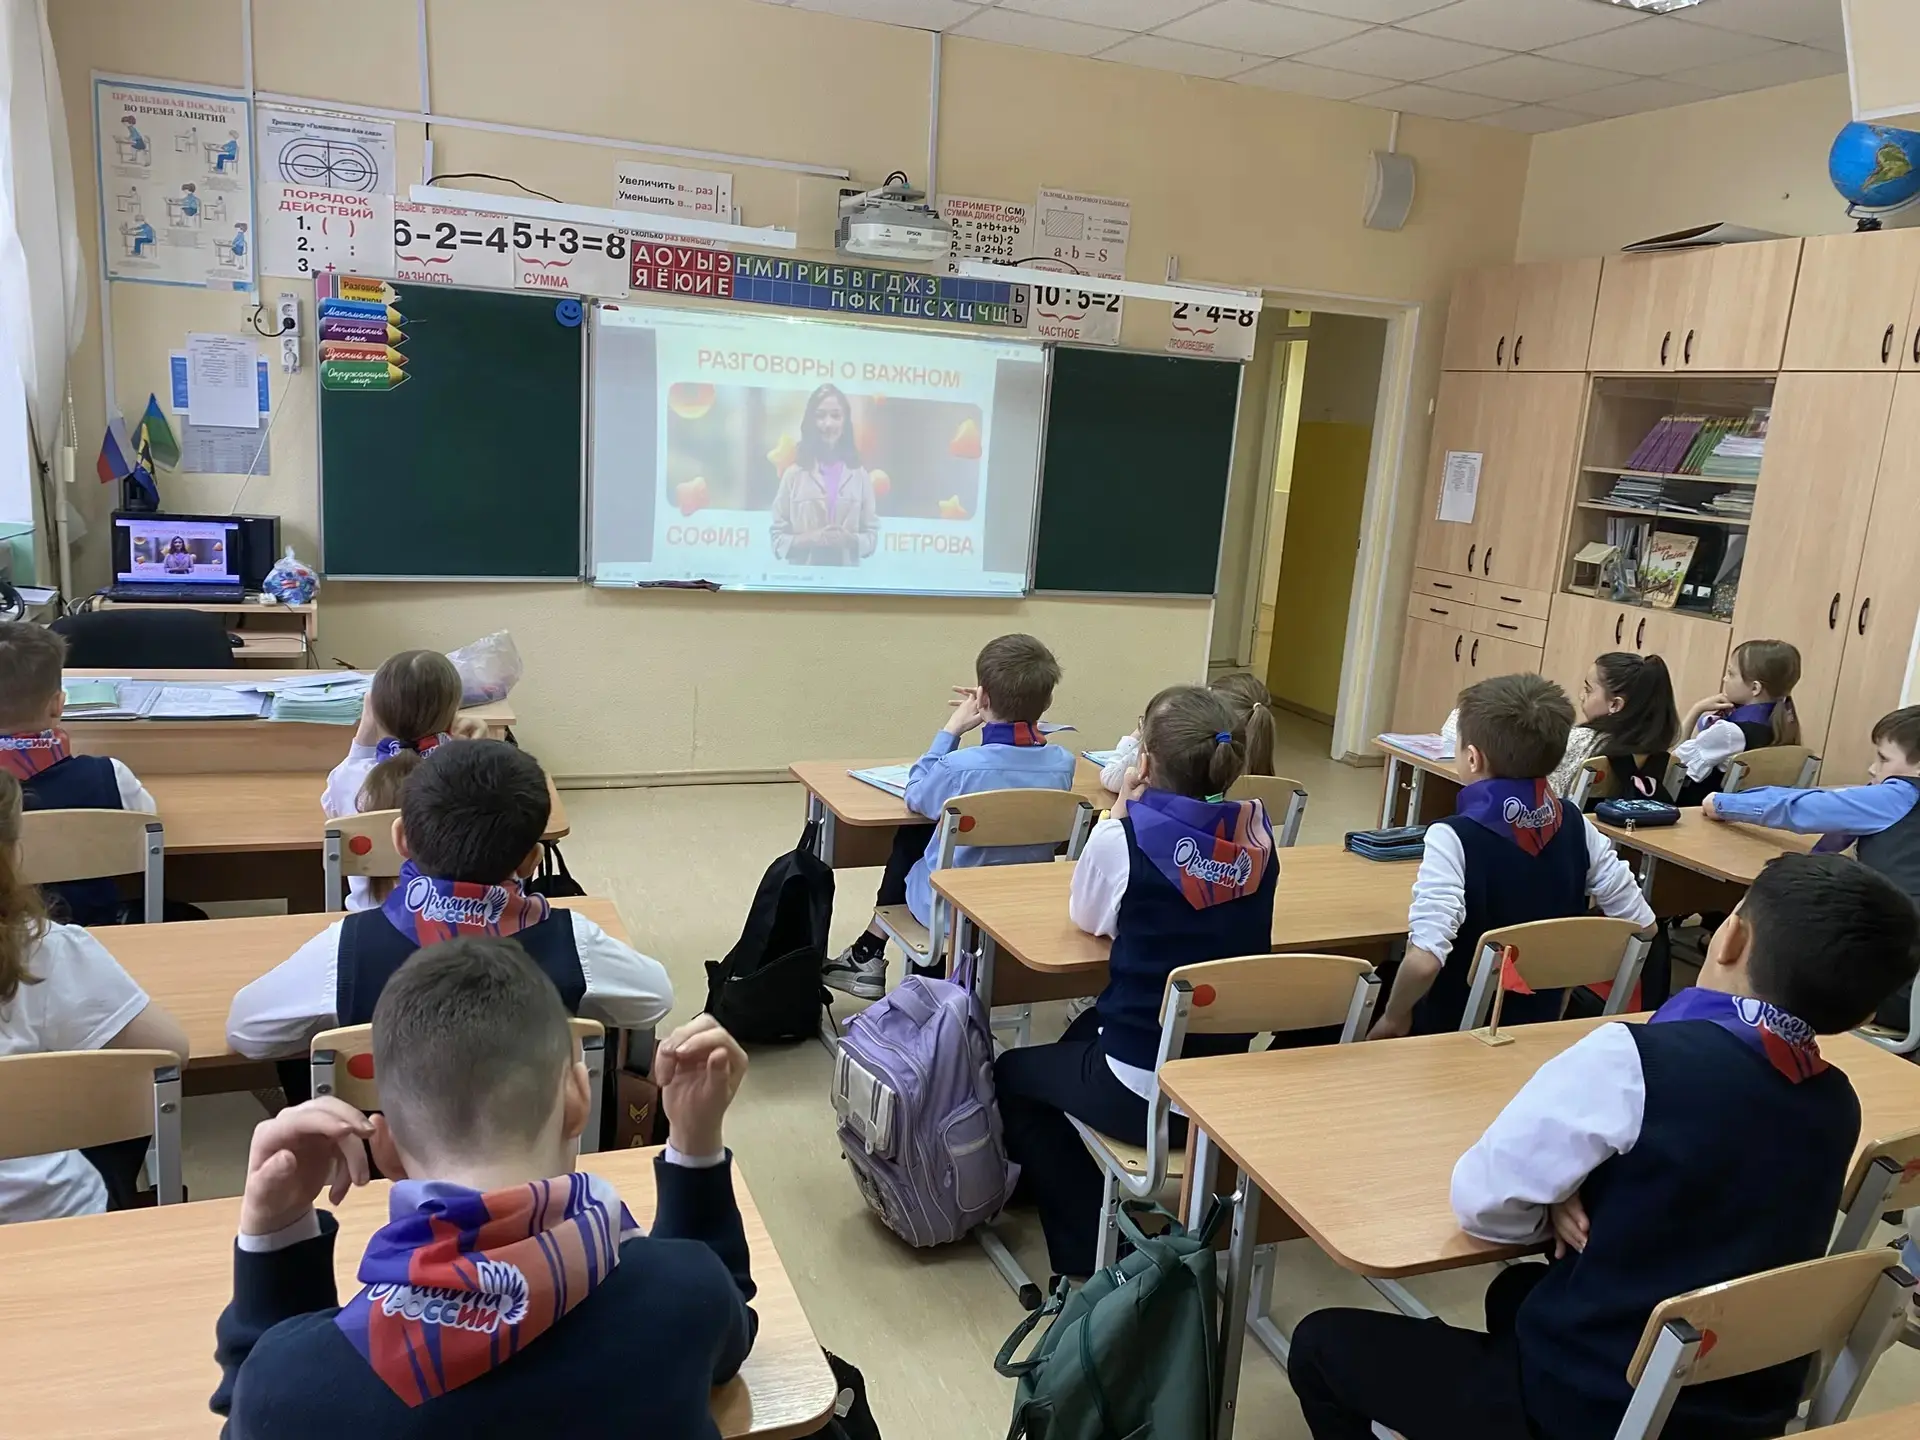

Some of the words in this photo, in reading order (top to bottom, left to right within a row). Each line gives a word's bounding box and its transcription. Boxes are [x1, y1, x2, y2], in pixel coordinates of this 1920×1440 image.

[124, 103, 137, 112] ВО
[140, 105, 174, 116] ВРЕМЯ
[176, 110, 226, 123] ЗАНЯТИЙ
[619, 175, 675, 191] Увеличить
[695, 187, 713, 196] раз
[283, 189, 368, 206] ПОРЯДОК
[618, 190, 675, 206] Уменьшить
[695, 202, 712, 211] раз
[278, 200, 374, 219] ДЕЙСТВИЙ
[944, 208, 973, 218] (СУММА
[974, 212, 995, 220] ДЛИН
[996, 214, 1027, 225] СТОРОН)
[948, 200, 1002, 212] ПЕРИМЕТР
[1004, 206, 1025, 217] (СМ)
[296, 215, 311, 230] 1.
[297, 236, 315, 252] 2.
[513, 222, 625, 260] 5+3=8
[630, 230, 663, 240] сколько
[664, 234, 679, 242] раз
[1072, 245, 1080, 259] b
[1098, 249, 1108, 262] S
[343, 281, 386, 293] Разговоры
[523, 272, 569, 288] СУММА
[324, 307, 388, 321] Математика
[328, 323, 383, 335] Английский
[1038, 325, 1080, 339] ЧАСТНОЕ
[325, 348, 363, 361] Русский
[328, 368, 389, 381] Окружающий
[698, 349, 835, 378] РАЗГОВОРЫ
[841, 362, 856, 380] О
[863, 362, 961, 389] ВАЖНОМ
[351, 378, 371, 387] мир
[666, 526, 750, 548] СОФИЯ
[884, 532, 974, 555] ПЕТРОВА
[1175, 838, 1238, 877] Орлята
[1188, 866, 1236, 888] РОССИИ
[407, 876, 487, 915] Орлята
[386, 1297, 499, 1331] РОССИИ
